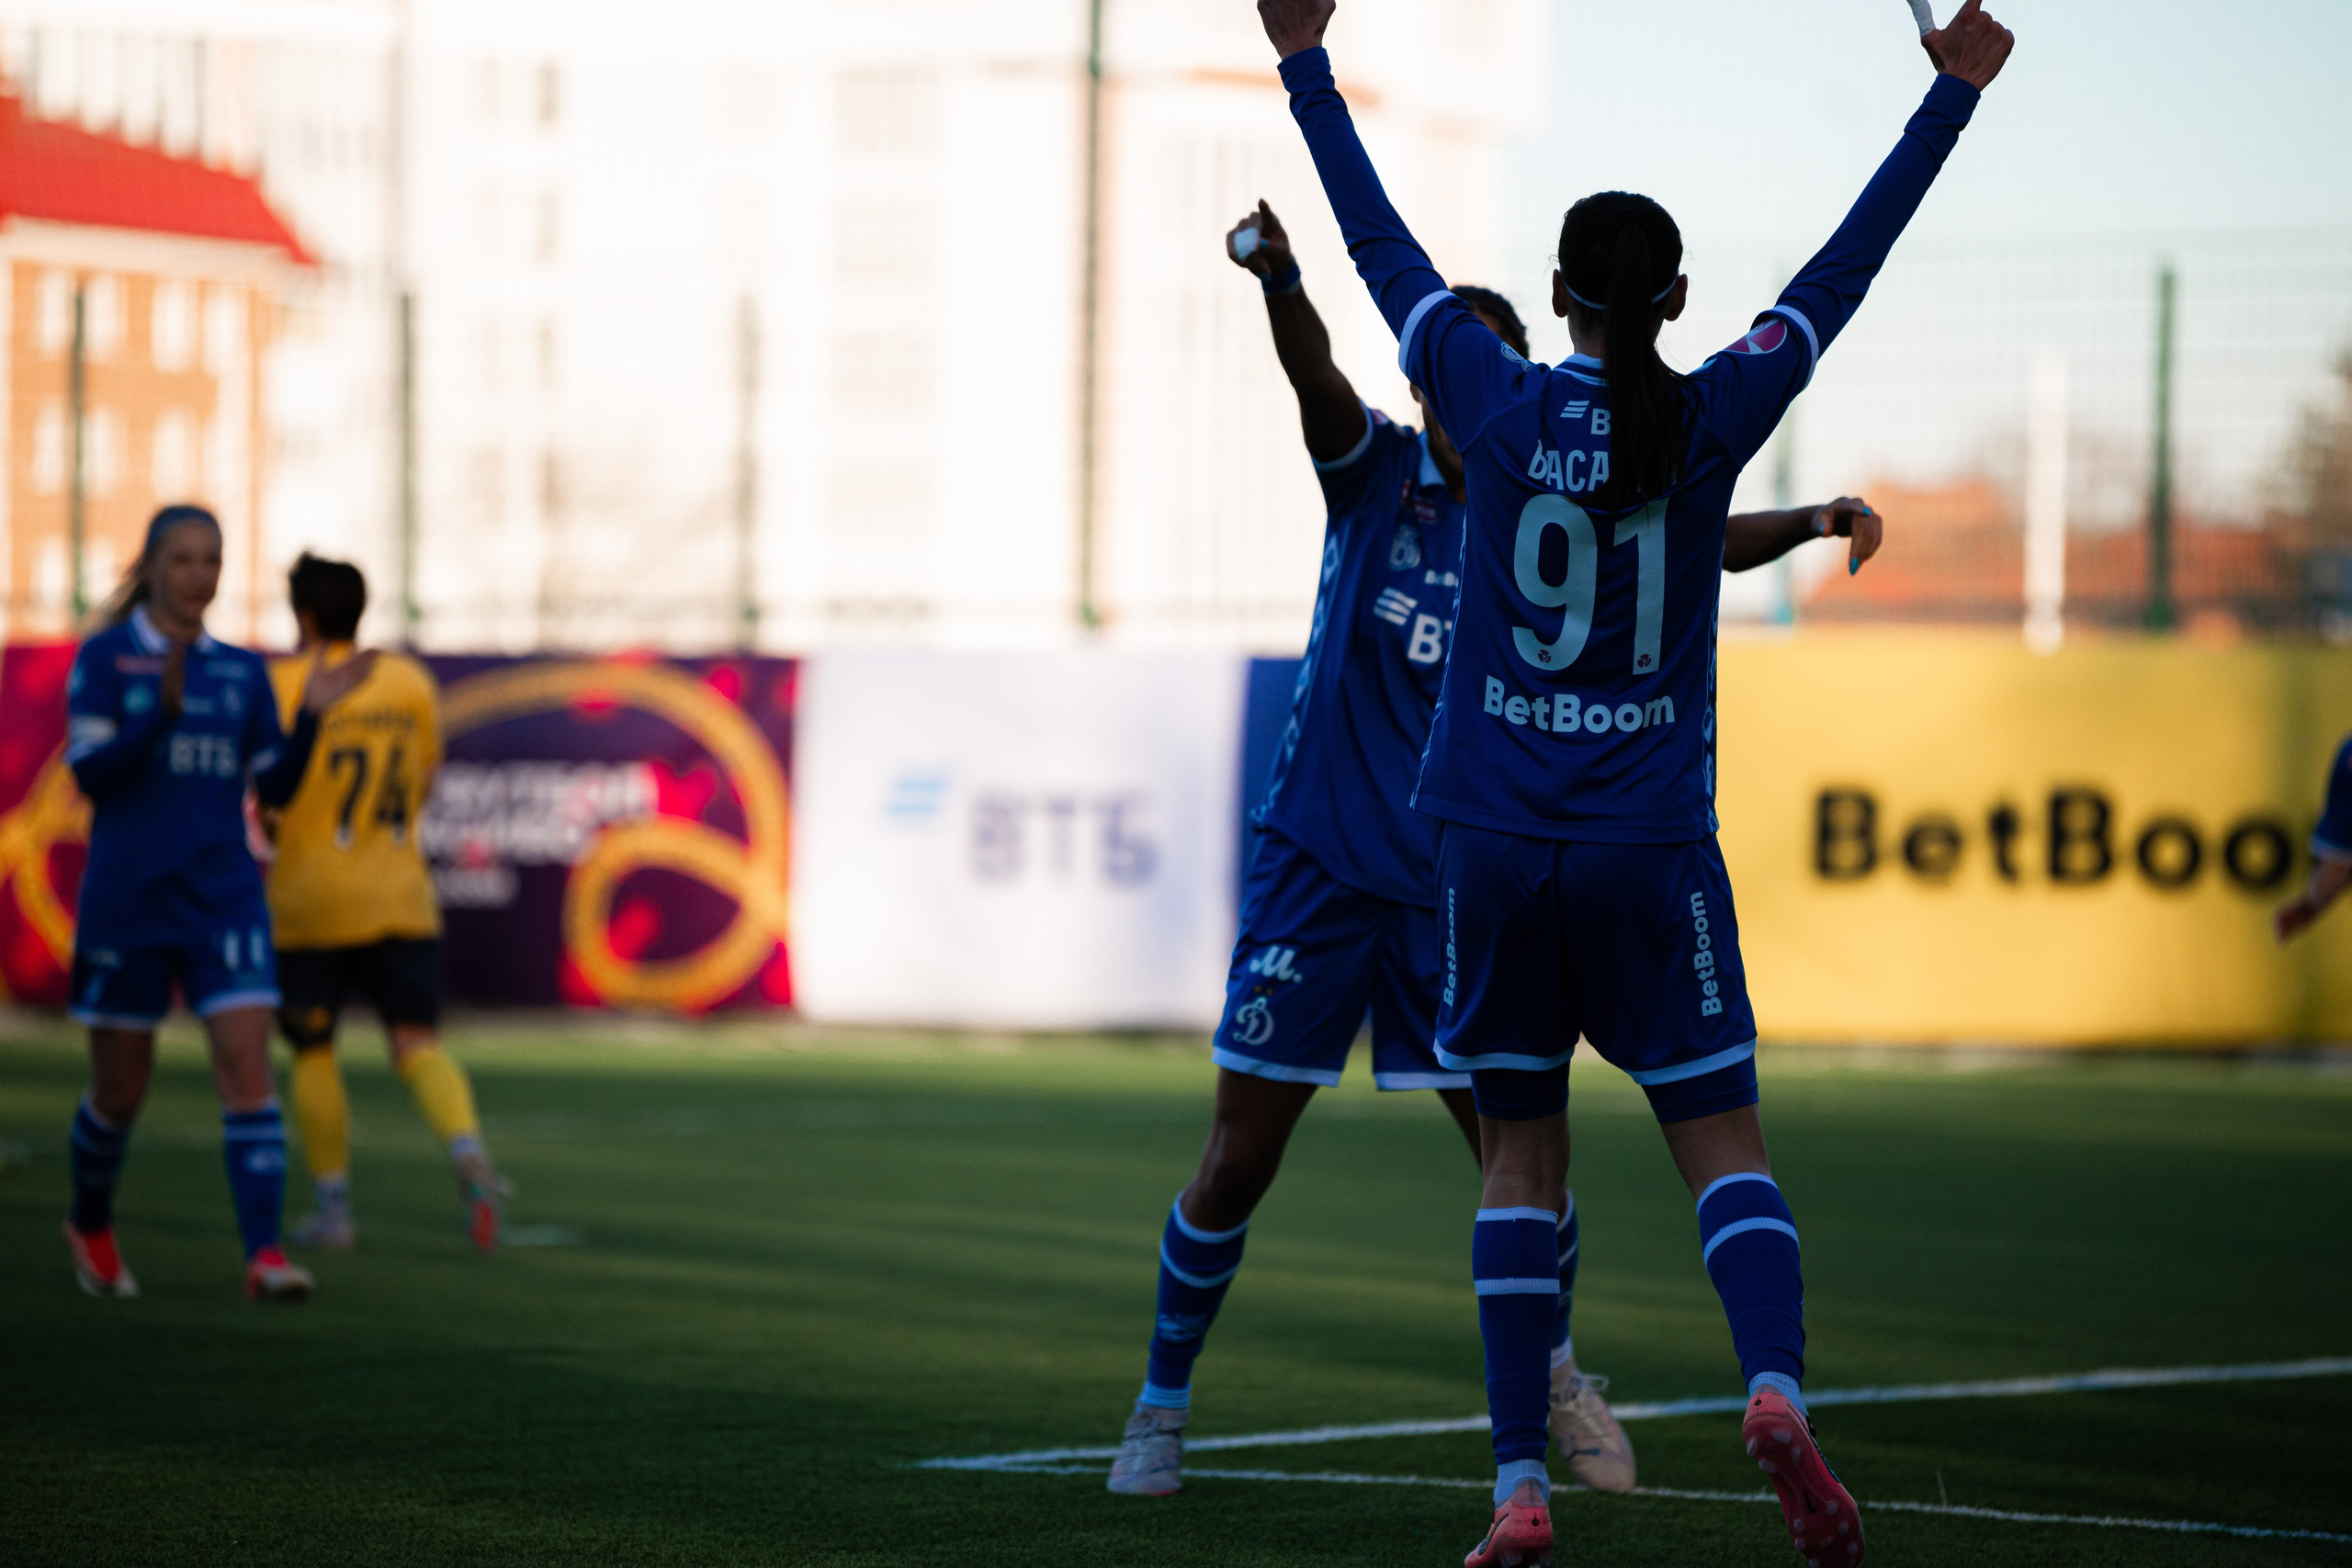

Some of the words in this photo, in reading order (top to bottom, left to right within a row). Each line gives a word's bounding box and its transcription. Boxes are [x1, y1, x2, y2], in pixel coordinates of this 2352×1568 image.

[1527, 439, 1610, 492] БАСА
[1512, 493, 1669, 675] 91
[1483, 674, 1676, 734] BetBoom
[329, 746, 407, 849] 74
[968, 790, 1161, 891] ВТБ
[1812, 783, 2295, 891] BetBoo
[1442, 887, 1457, 1008] BetBoom
[1690, 891, 1724, 1017] BetBoom
